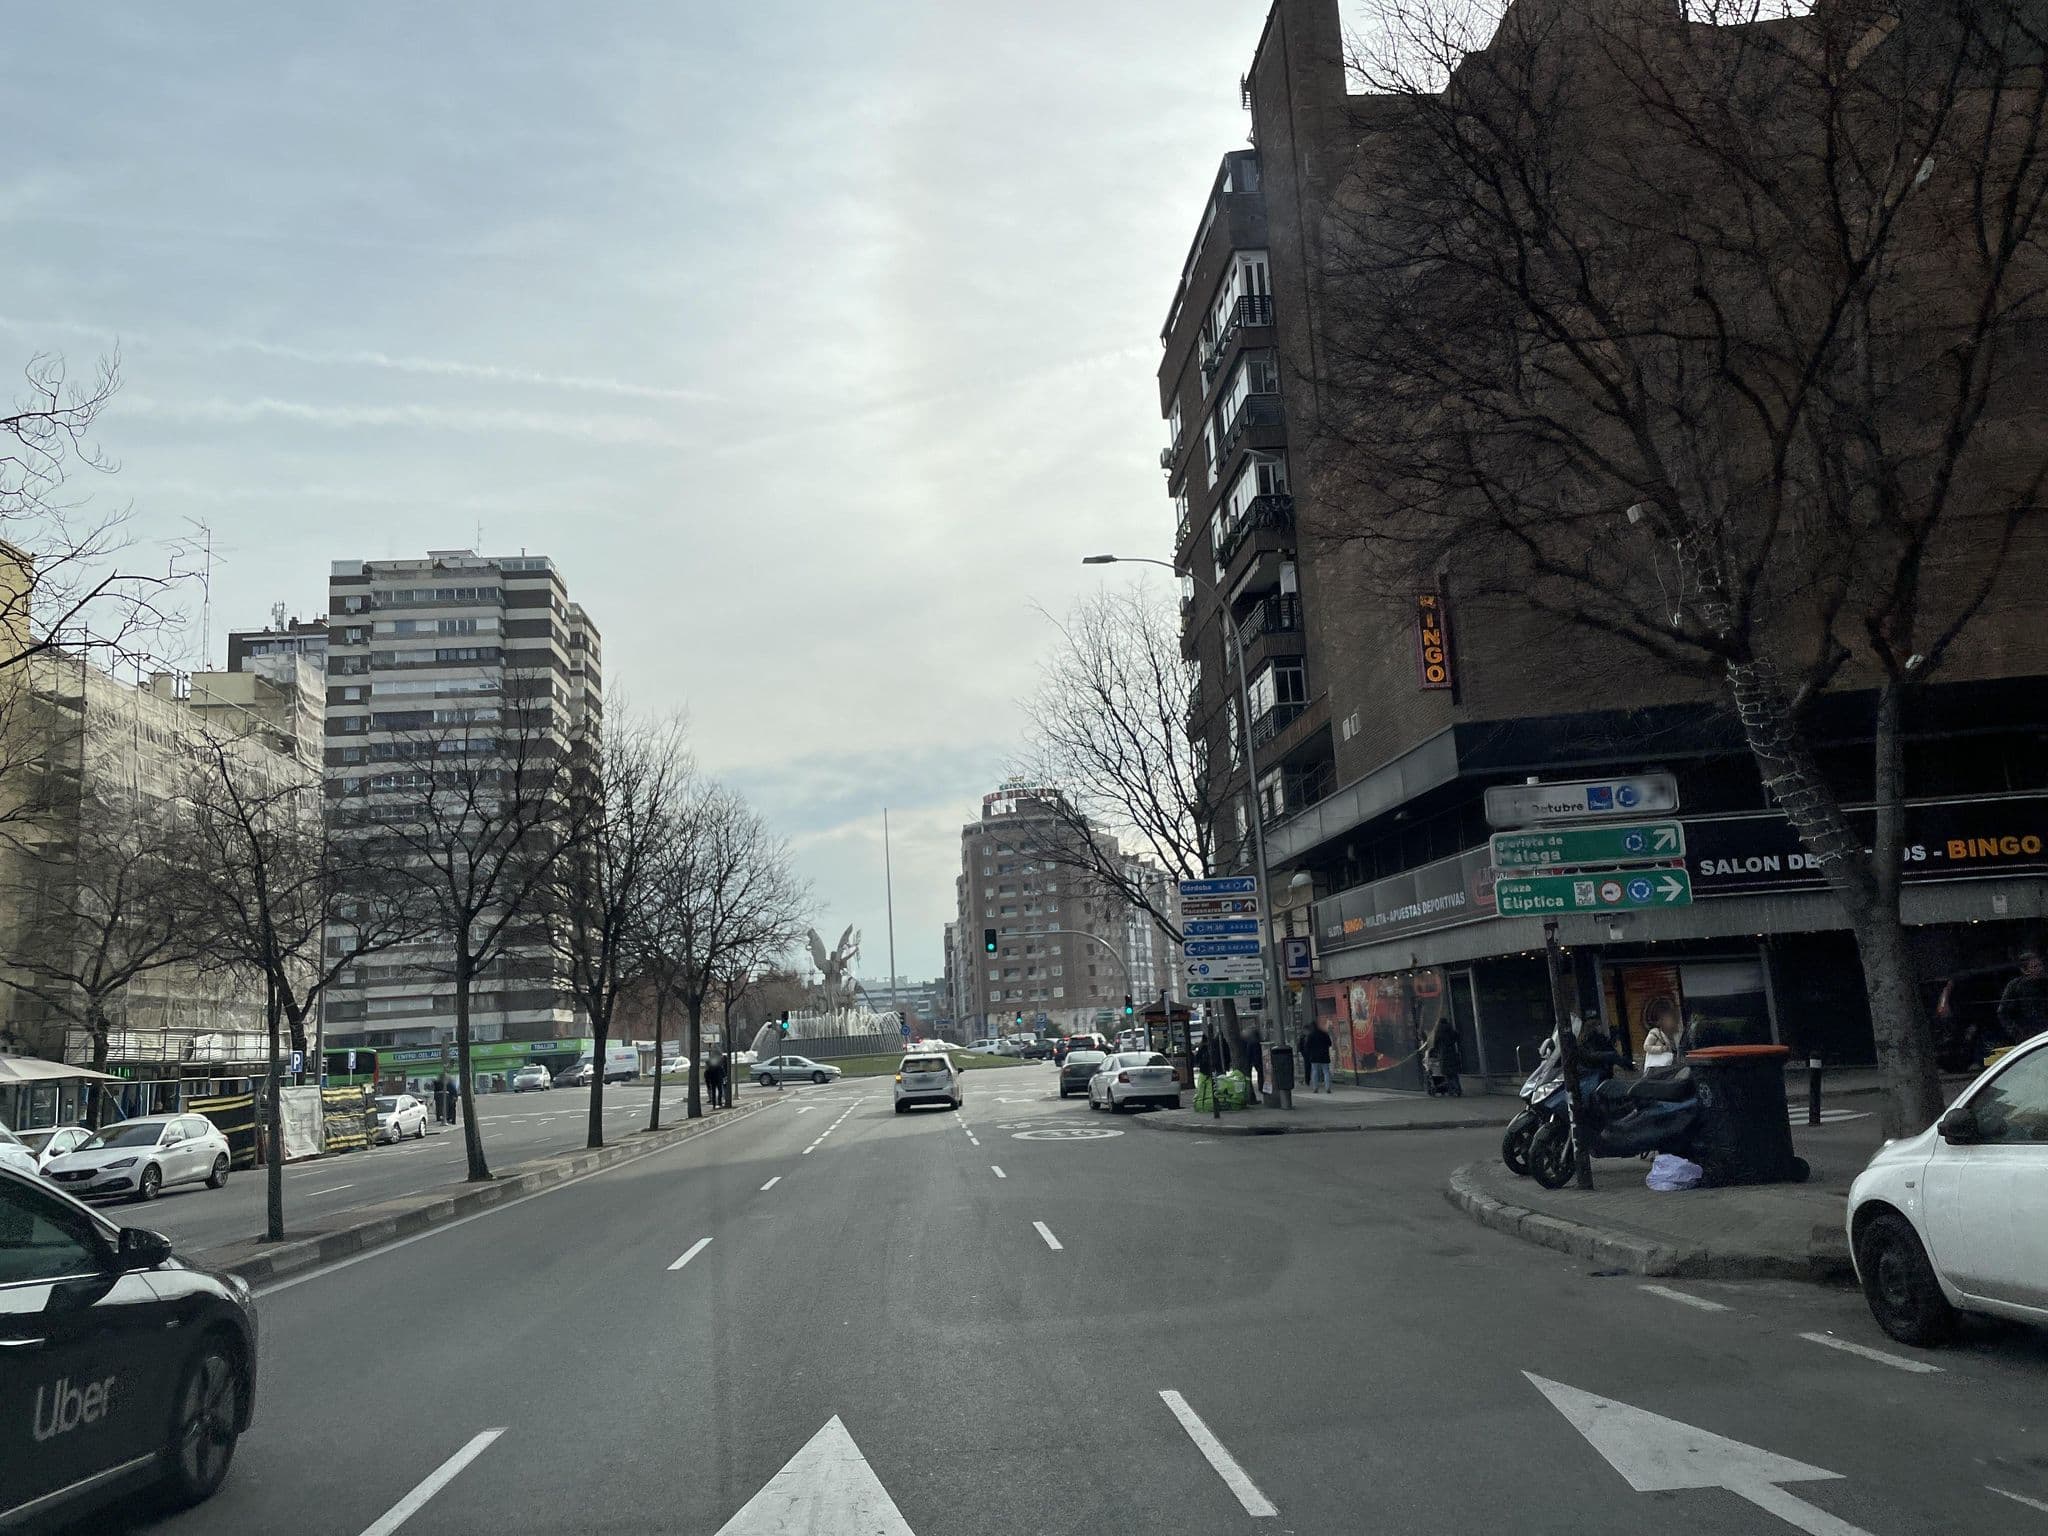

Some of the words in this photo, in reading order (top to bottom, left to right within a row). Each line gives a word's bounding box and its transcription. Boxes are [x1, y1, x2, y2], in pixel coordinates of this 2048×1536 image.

[1700, 855, 1781, 876] SALON
[1946, 834, 2042, 859] BINGO
[1181, 882, 1212, 892] Córdoba
[1390, 903, 1422, 922] APUESTAS
[1422, 891, 1466, 913] DEPORTIVAS
[1288, 943, 1306, 966] P
[293, 1053, 301, 1070] P
[349, 1052, 355, 1065] P
[33, 1375, 116, 1442] Uber
